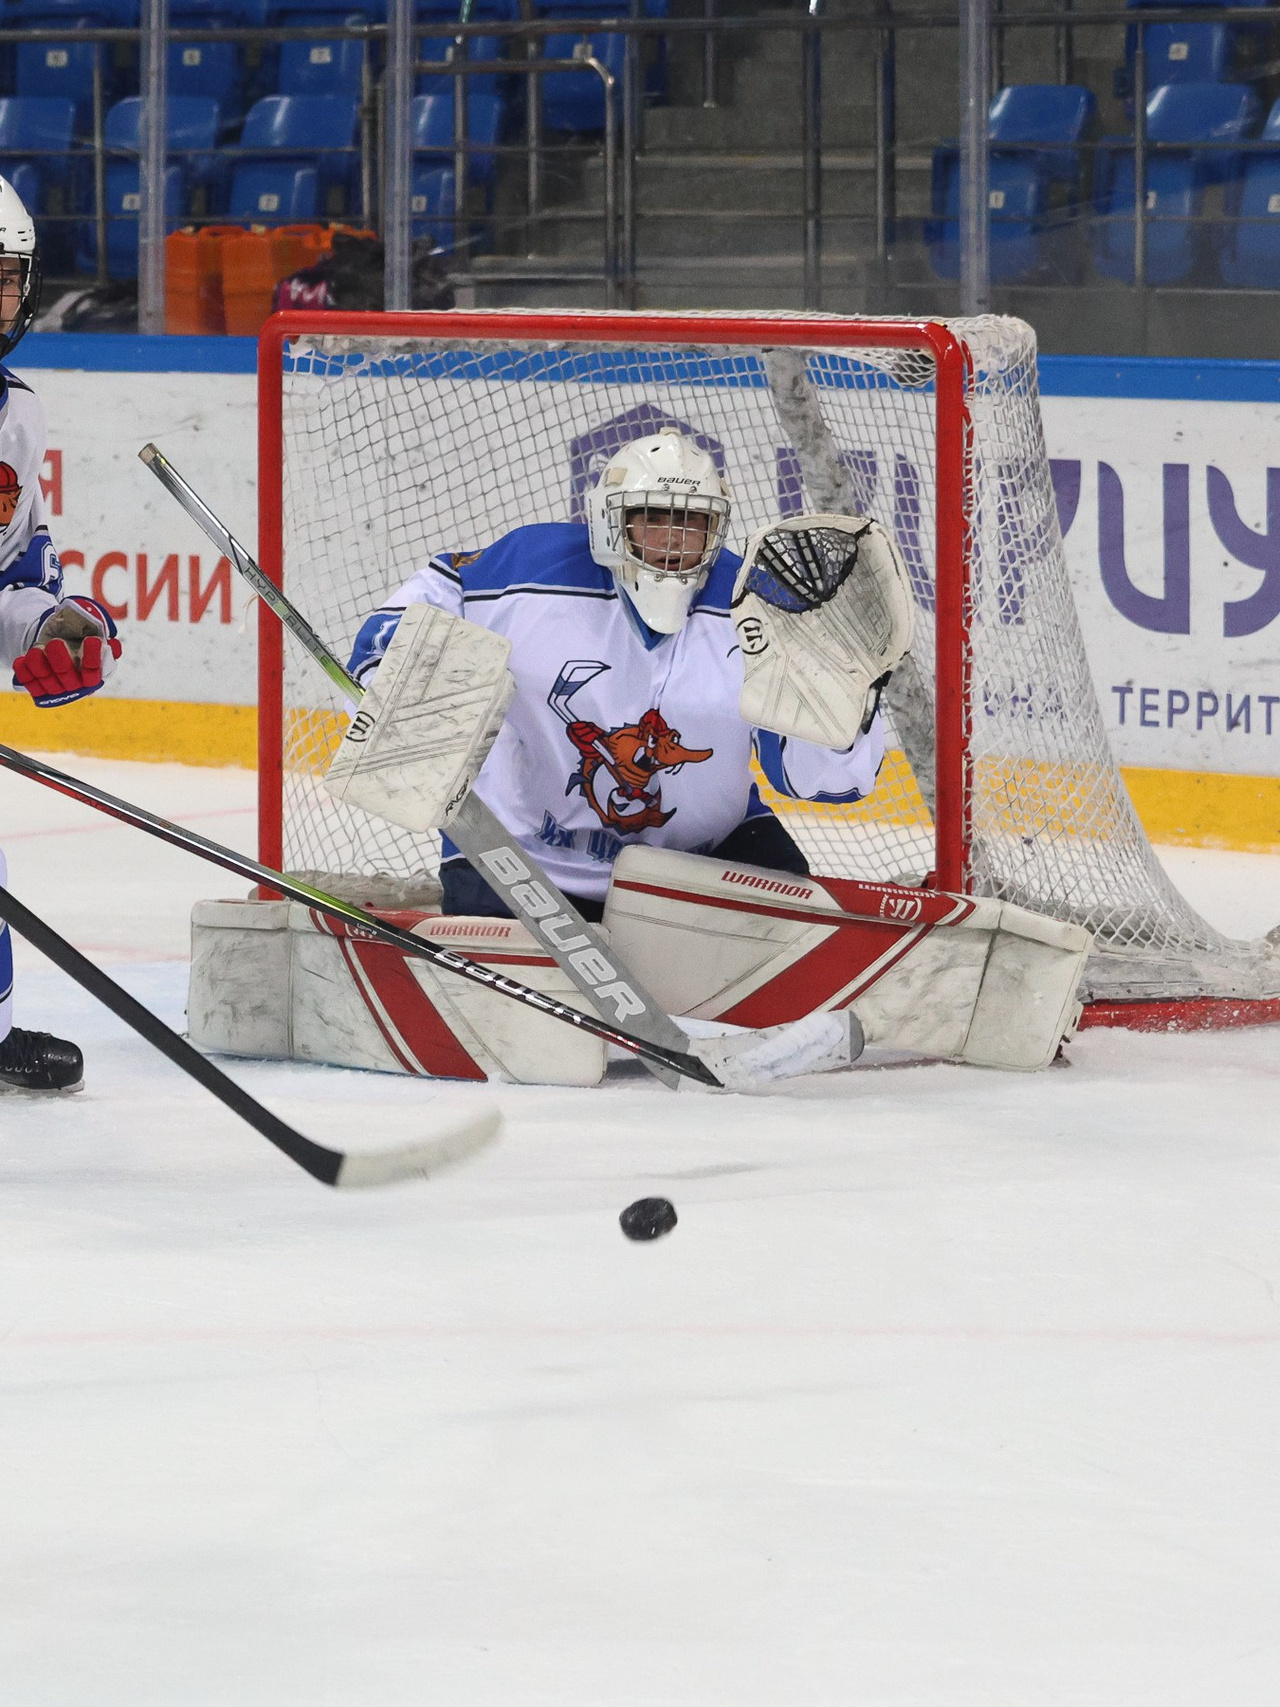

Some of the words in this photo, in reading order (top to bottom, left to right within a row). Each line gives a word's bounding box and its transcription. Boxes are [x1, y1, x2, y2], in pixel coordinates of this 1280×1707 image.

[657, 475, 702, 487] BAUER
[721, 870, 813, 900] WARRIOR
[429, 924, 512, 938] WARRIOR
[478, 846, 647, 1024] BAUER
